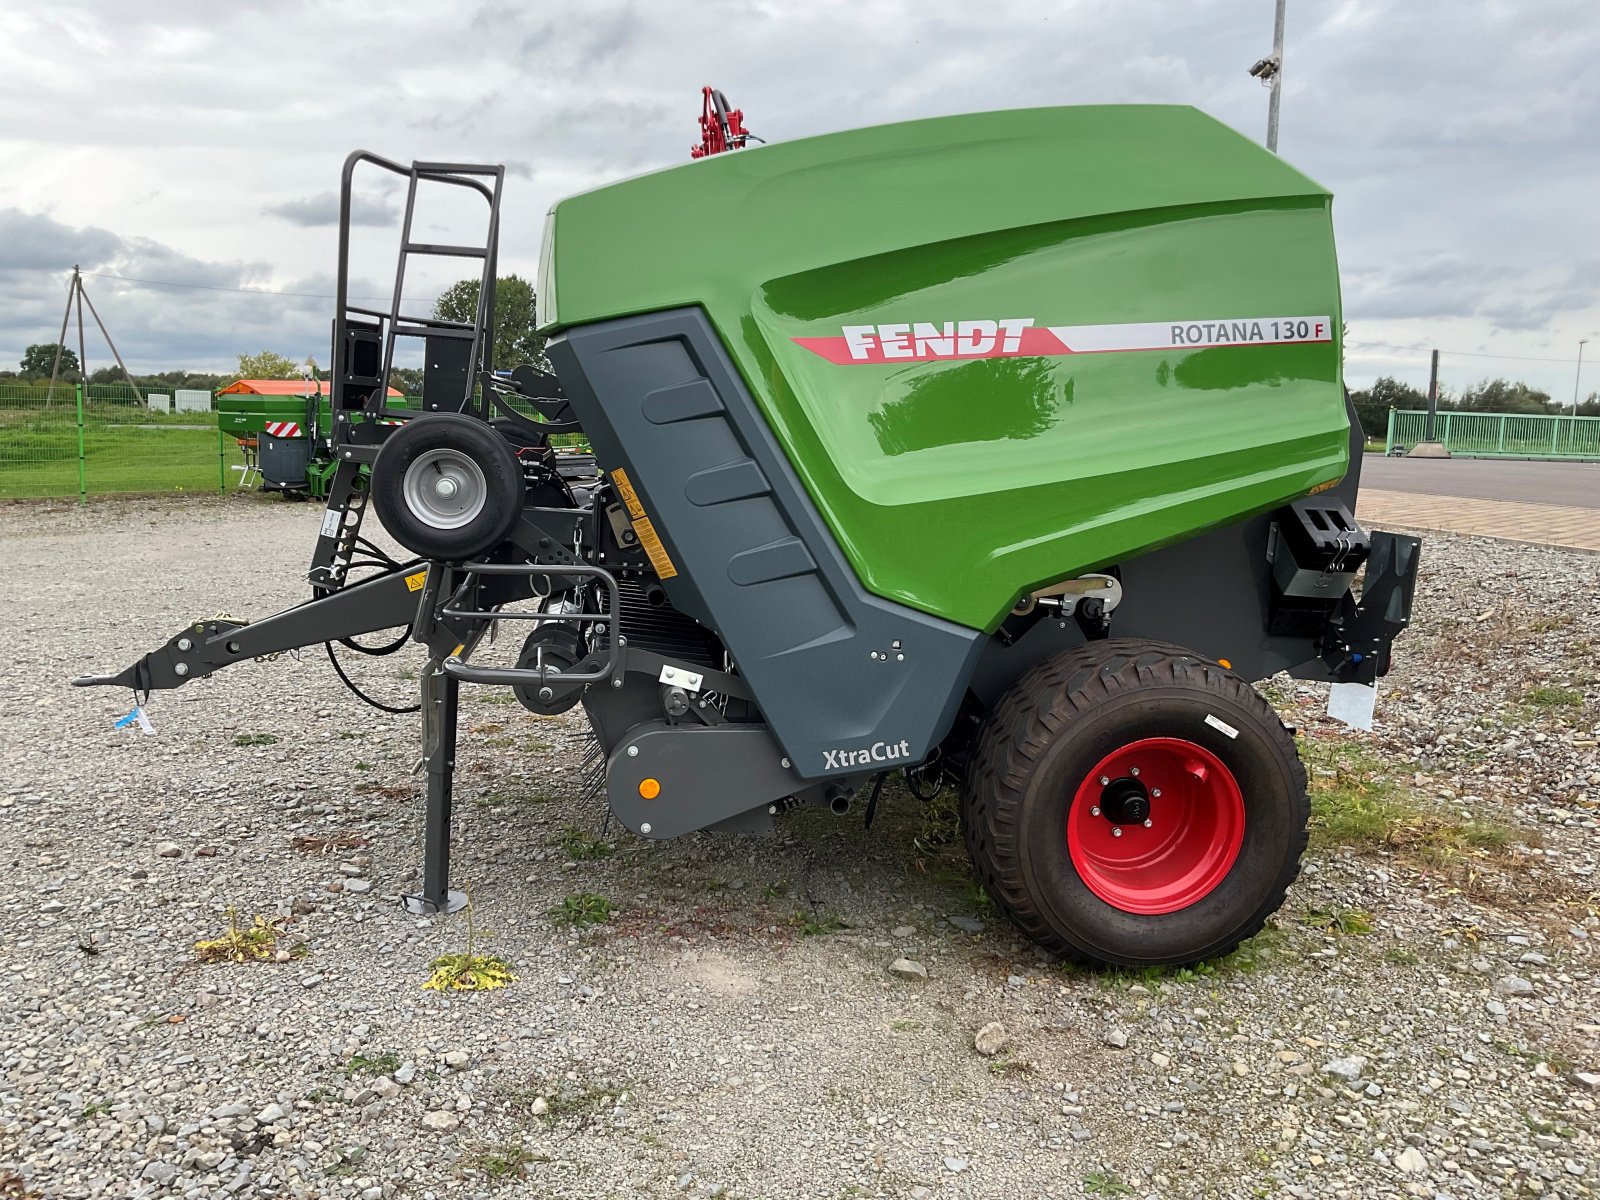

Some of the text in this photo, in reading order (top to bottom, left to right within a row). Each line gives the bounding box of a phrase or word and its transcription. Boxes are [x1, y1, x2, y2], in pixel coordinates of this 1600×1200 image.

[841, 317, 1035, 360] FENDT
[1170, 320, 1324, 345] ROTANA 130 F
[822, 739, 910, 770] XtraCut
